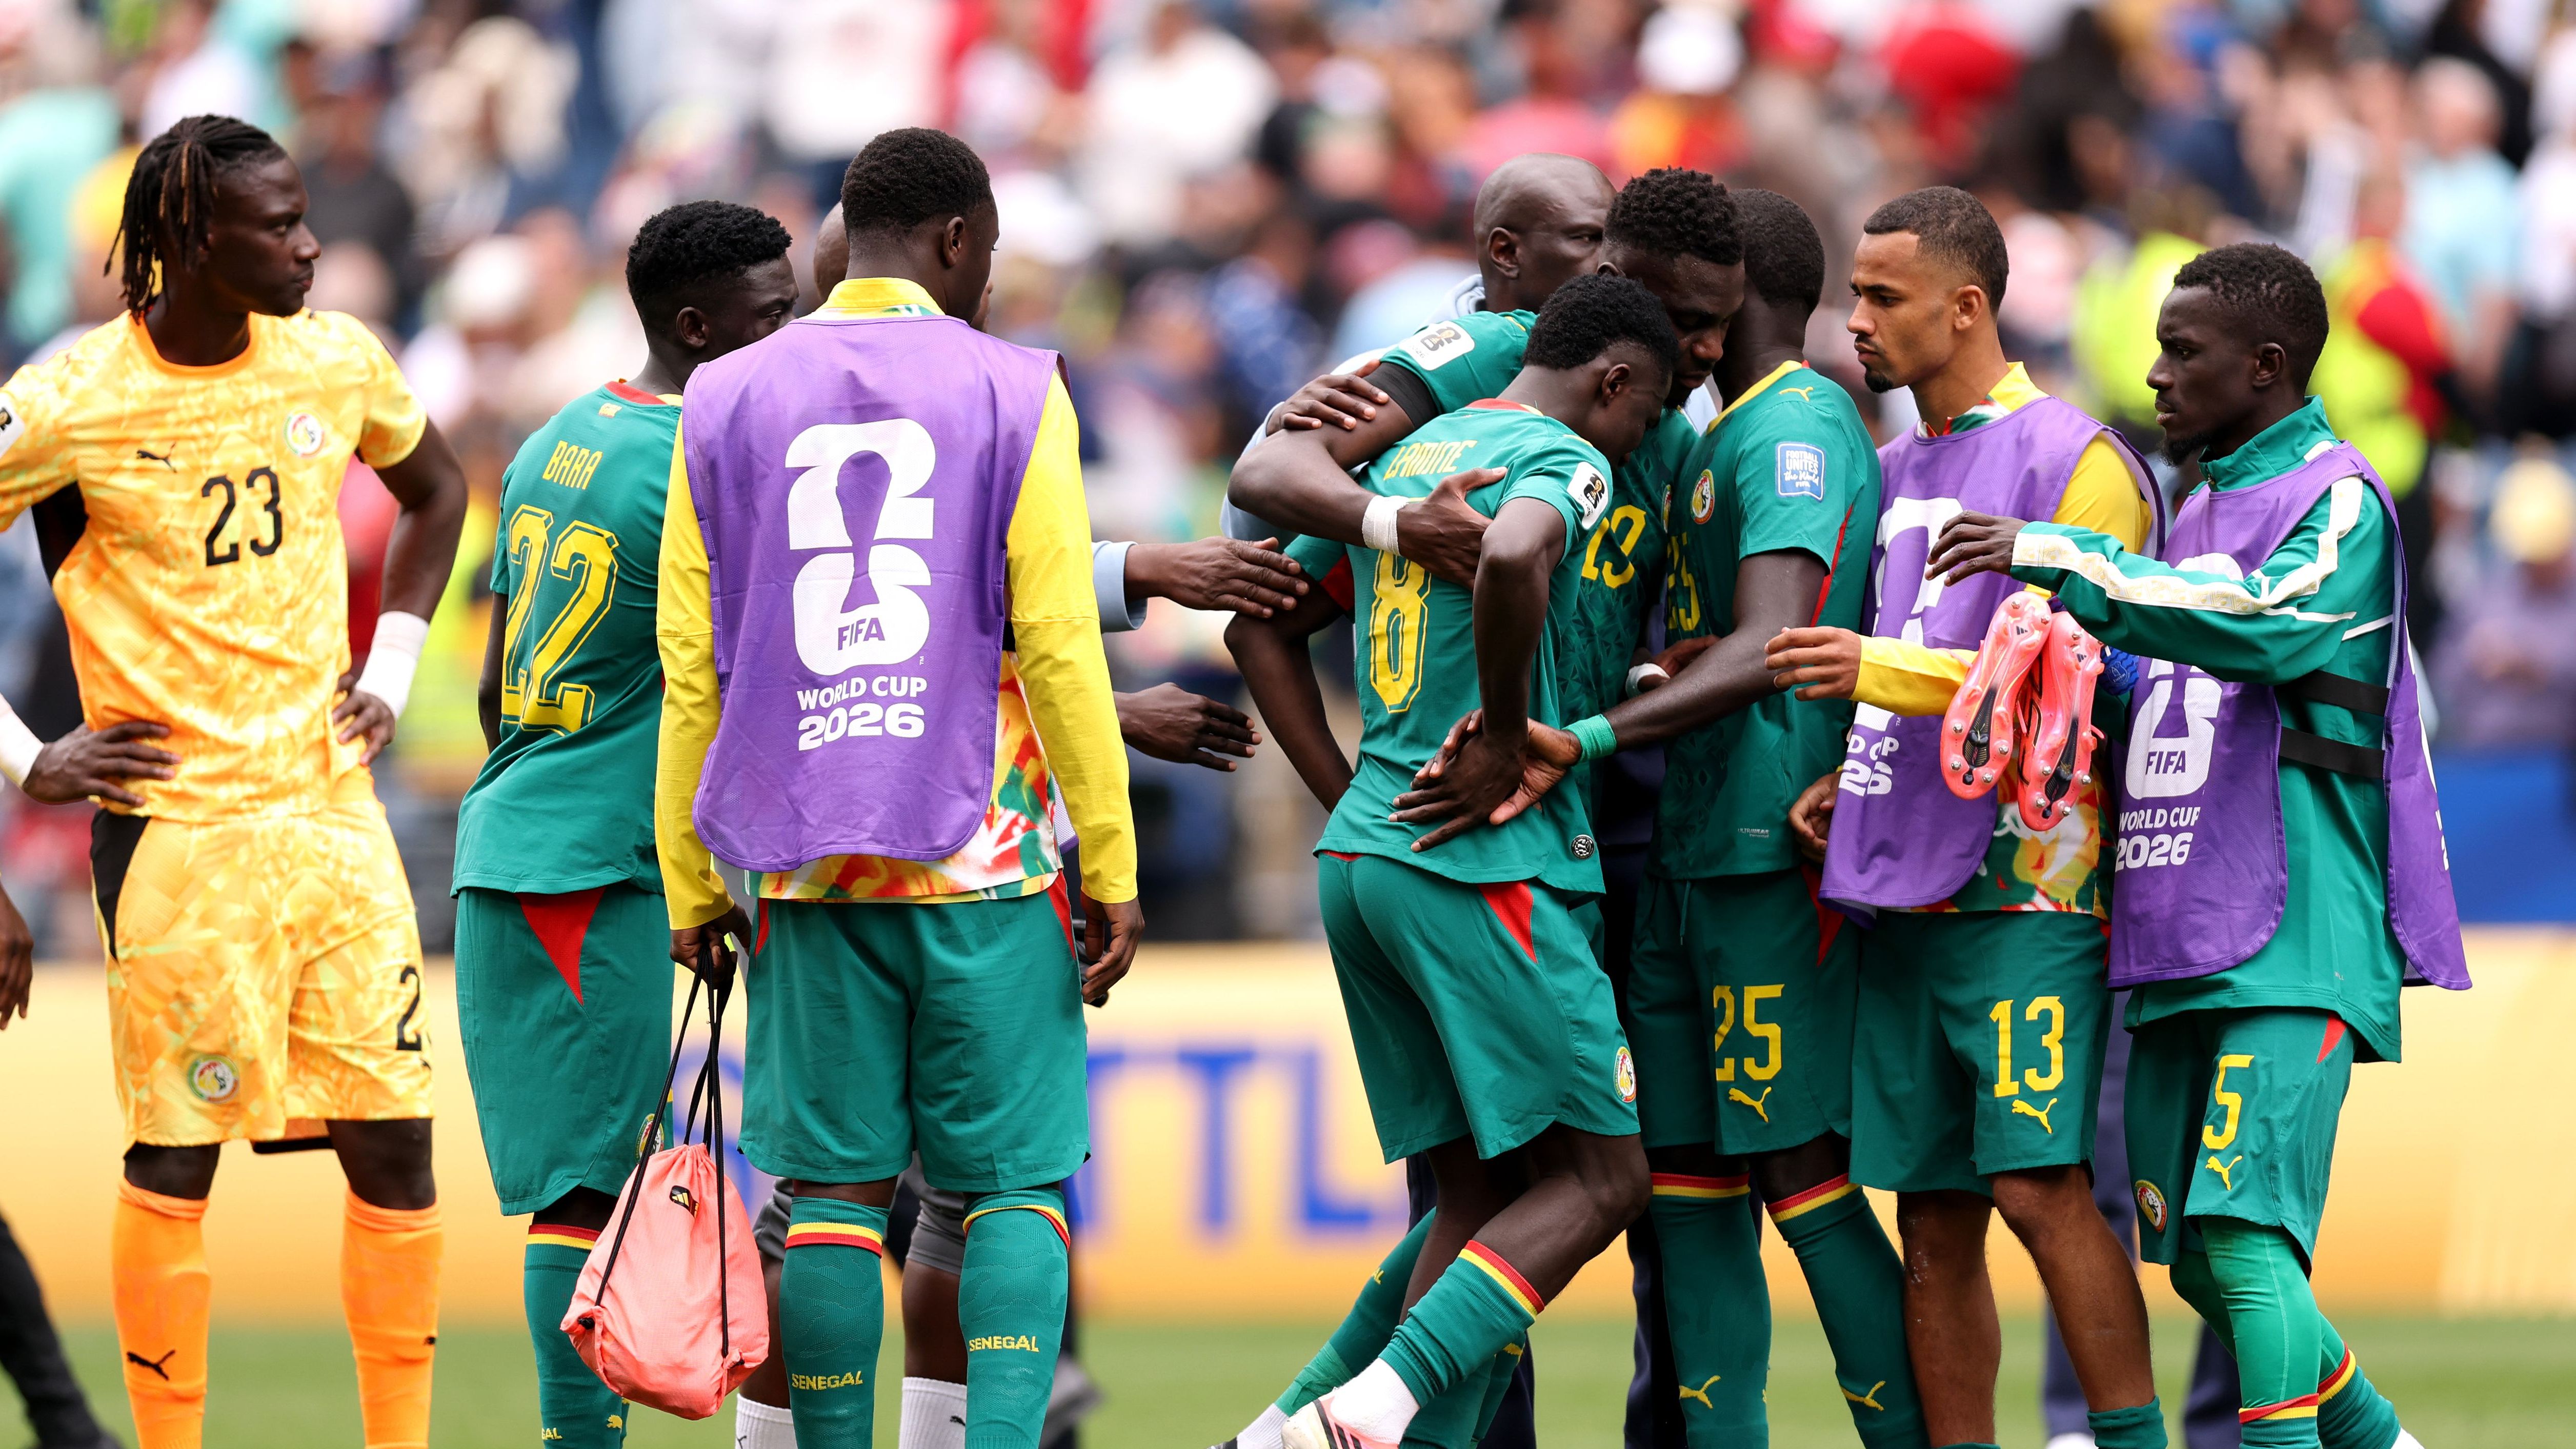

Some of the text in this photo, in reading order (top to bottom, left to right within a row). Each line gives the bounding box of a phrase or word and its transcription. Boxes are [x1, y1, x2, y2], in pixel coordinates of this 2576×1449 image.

[542, 441, 602, 490] BARA
[1383, 439, 1478, 481] LAMINE
[1786, 450, 1818, 464] FOOTBALL
[1786, 458, 1818, 475] UNITES
[1784, 470, 1819, 486] the World
[201, 466, 283, 567] 23
[1581, 505, 1646, 589] 19
[501, 504, 620, 737] 22
[1370, 497, 1431, 713] 8
[838, 617, 886, 650] FIFA
[797, 676, 927, 711] WORLD CUP
[798, 703, 924, 751] 2026
[1869, 736, 1899, 761] CP
[2145, 750, 2186, 775] FIFA
[1838, 759, 1893, 797] 26
[2119, 807, 2201, 832] WORLD CUP
[2115, 832, 2193, 873] 2026
[396, 966, 422, 1051] 2
[1713, 984, 1784, 1082] 25
[1989, 995, 2064, 1098] 13
[2202, 1054, 2254, 1150] 5
[969, 1335, 1040, 1353] SENEGAL
[792, 1370, 863, 1391] SENEGAL
